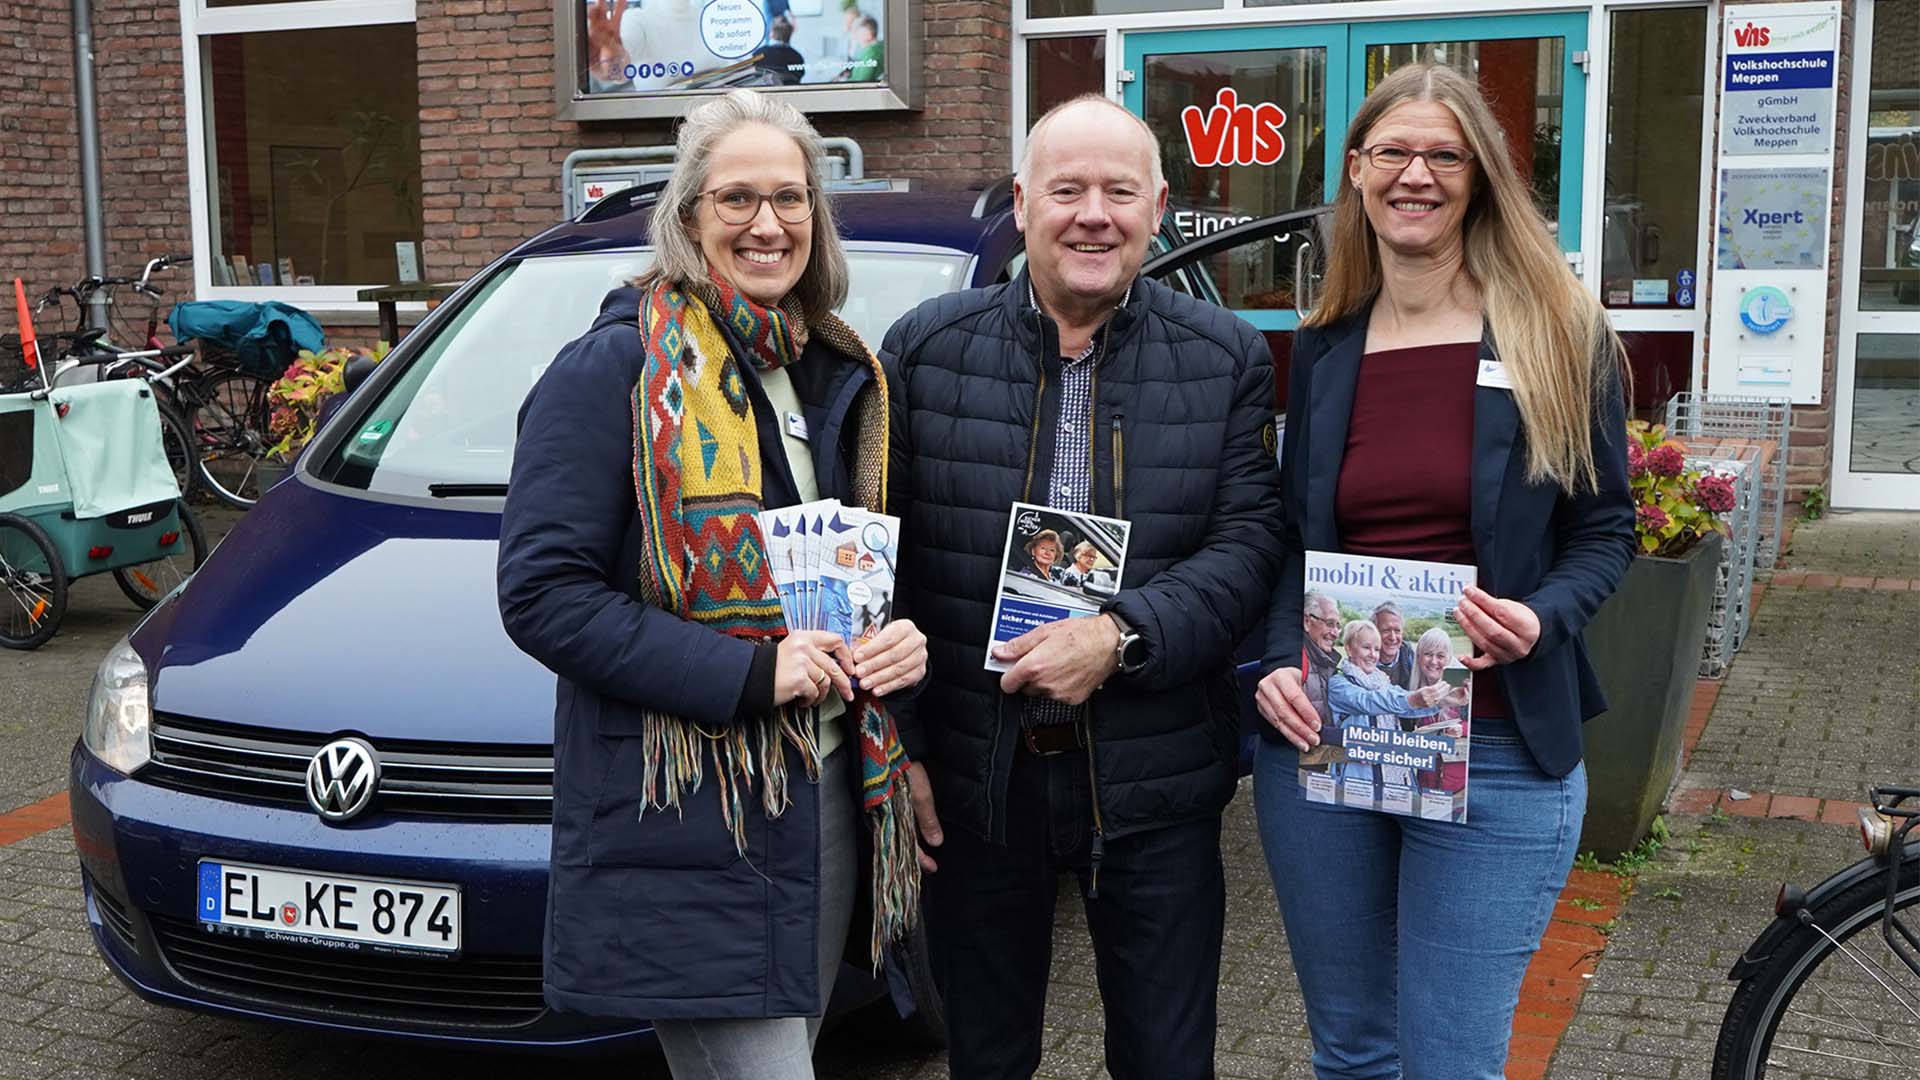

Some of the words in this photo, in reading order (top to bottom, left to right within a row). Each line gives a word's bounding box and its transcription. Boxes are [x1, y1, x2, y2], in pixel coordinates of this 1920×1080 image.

[710, 17, 752, 26] Programm
[727, 29, 751, 38] sofort
[1734, 22, 1771, 47] vhs
[1732, 58, 1828, 70] Volkshochschule
[1732, 73, 1779, 84] Meppen
[1757, 96, 1798, 108] gGmbH
[1738, 113, 1817, 124] Zweckverband
[1181, 87, 1287, 167] vhs
[1733, 125, 1821, 136] Volkshochschule
[1754, 138, 1798, 148] Meppen
[1743, 208, 1803, 229] Xpert
[128, 512, 153, 524] THULE
[1309, 562, 1374, 586] mobil
[1381, 565, 1401, 590] &
[1001, 614, 1024, 623] sicher
[1350, 726, 1389, 744] Mobil
[1393, 732, 1452, 754] bleiben,
[1348, 747, 1381, 762] aber
[1383, 751, 1433, 769] sicher!
[206, 897, 215, 910] D
[225, 872, 276, 921] EL
[305, 881, 358, 932] KE
[372, 888, 452, 941] 874
[264, 931, 361, 951] Schwarte-Gruppe.de
